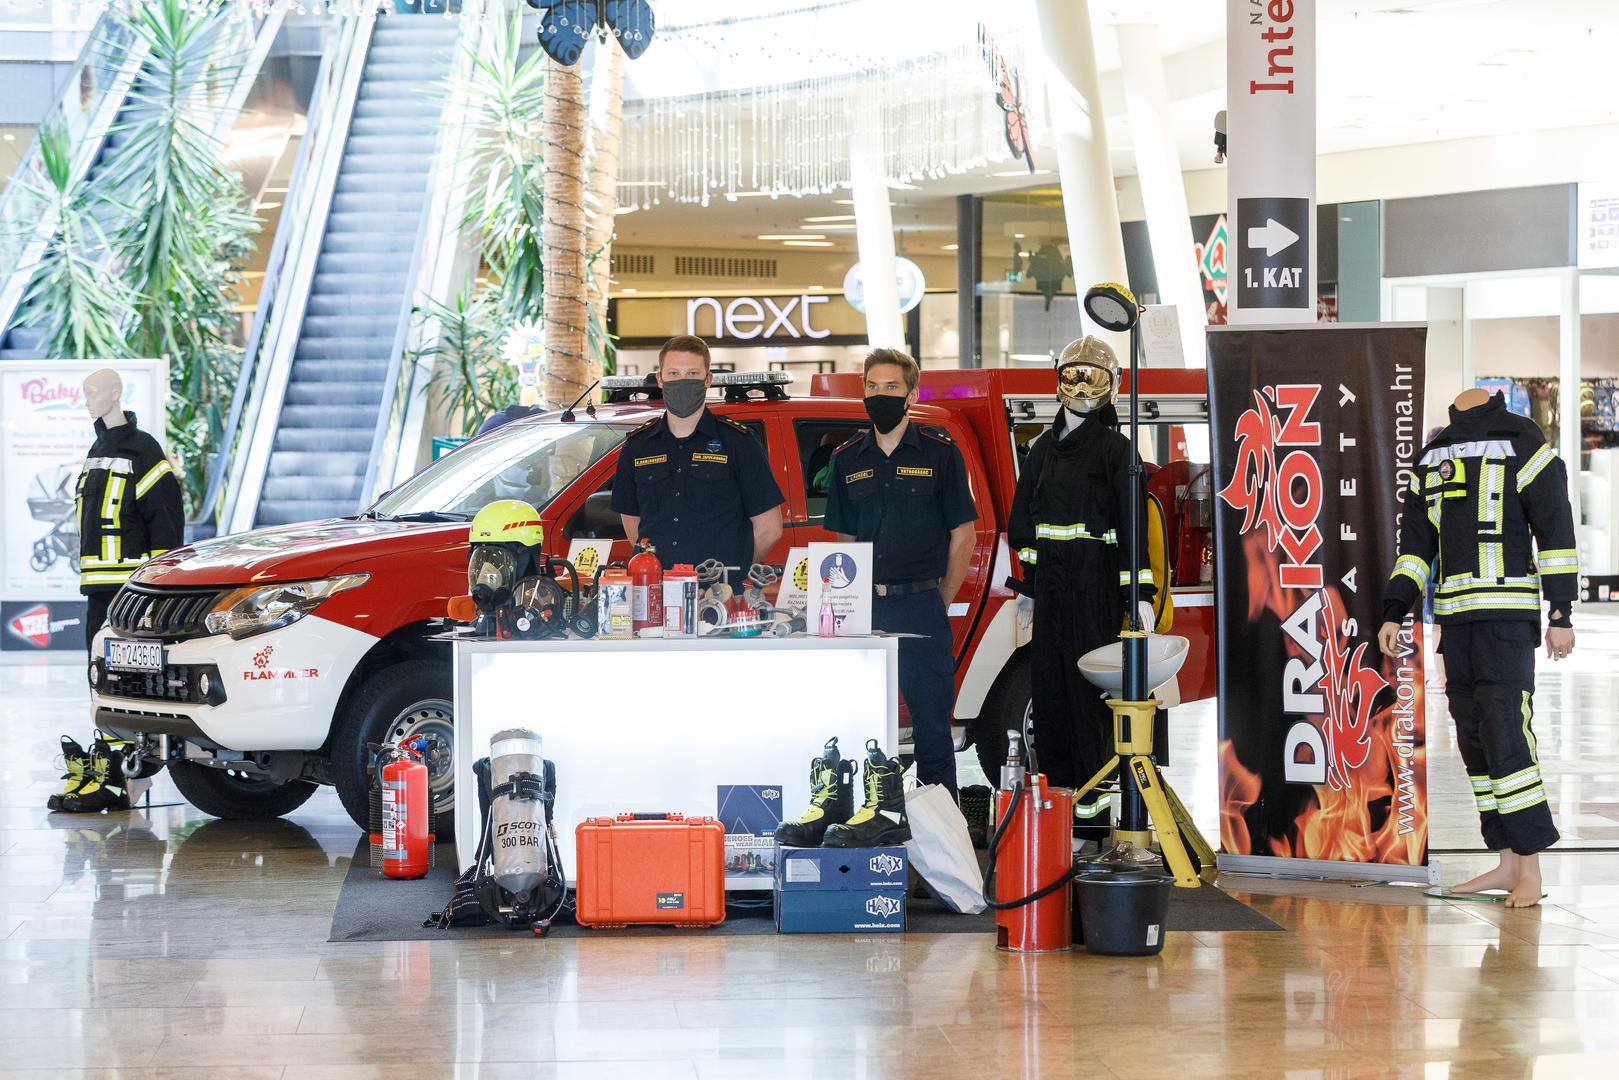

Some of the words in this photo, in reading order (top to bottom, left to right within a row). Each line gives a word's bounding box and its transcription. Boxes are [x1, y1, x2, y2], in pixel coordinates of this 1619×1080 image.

[1244, 267, 1259, 288] 1.
[1263, 267, 1303, 288] KAT
[686, 295, 832, 340] next
[21, 377, 80, 405] Baby
[1338, 383, 1358, 637] SAFETY
[1275, 384, 1326, 785] DRAKON
[111, 643, 122, 664] ZG
[510, 821, 543, 831] SCOTT
[501, 836, 516, 848] 300
[519, 835, 539, 847] BAR
[754, 838, 774, 847] HAI
[870, 855, 902, 874] HAIX
[866, 896, 900, 915] HAIX
